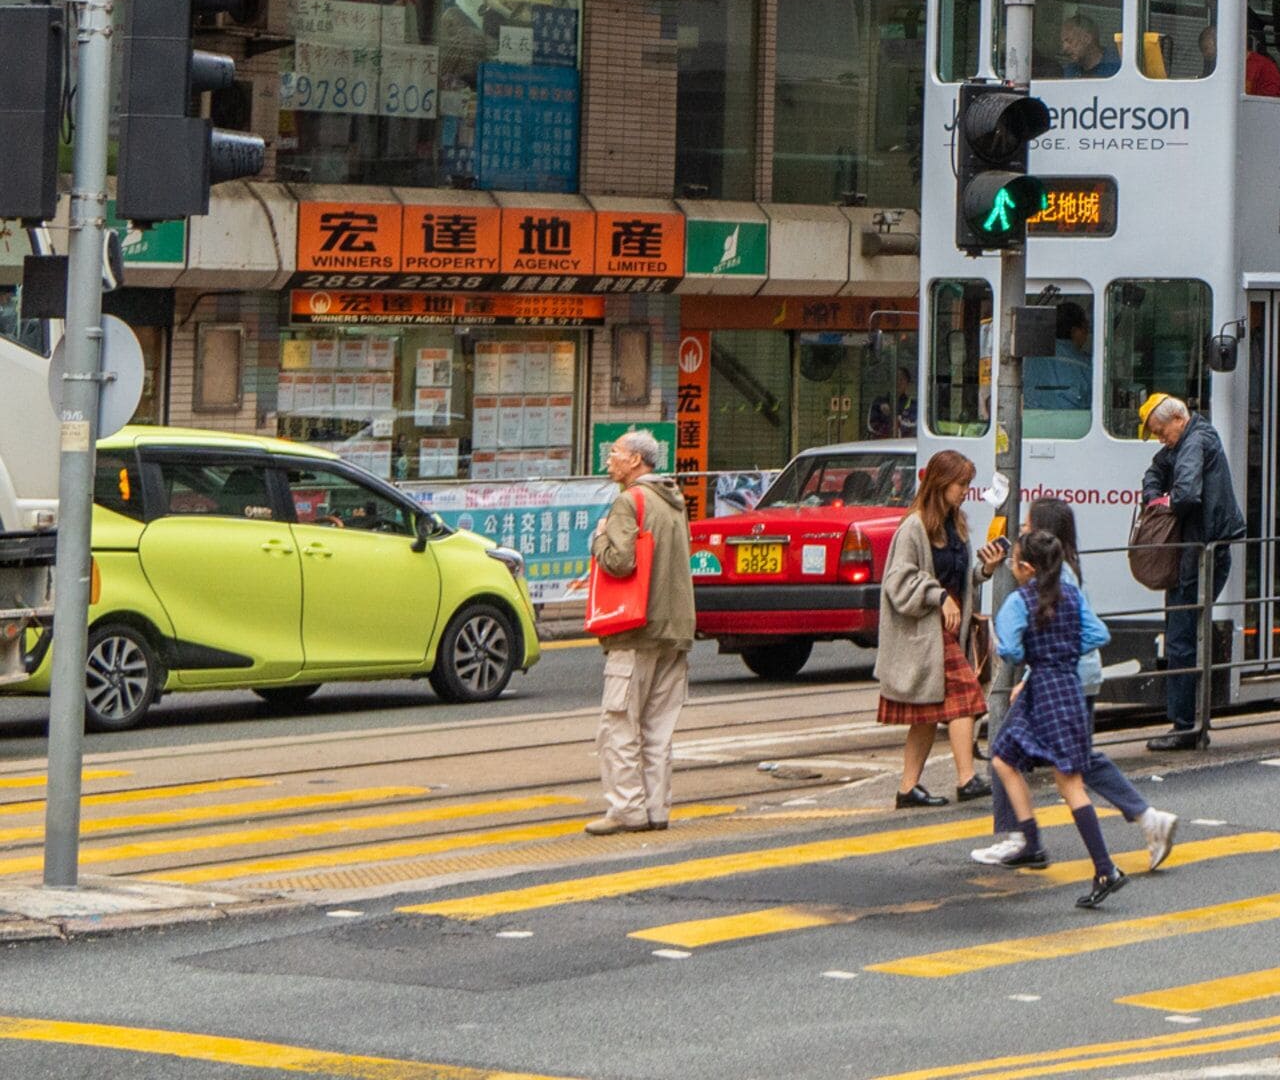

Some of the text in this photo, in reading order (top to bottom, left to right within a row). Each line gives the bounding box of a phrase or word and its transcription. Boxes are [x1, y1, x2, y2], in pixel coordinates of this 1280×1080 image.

[1079, 138, 1165, 150] SHARED
[319, 211, 664, 259] 宏達地產
[311, 256, 667, 273] WINNERS PROPERTY AGENCY LIMITED
[303, 275, 483, 290] 2857 2238
[741, 557, 778, 573] 3823
